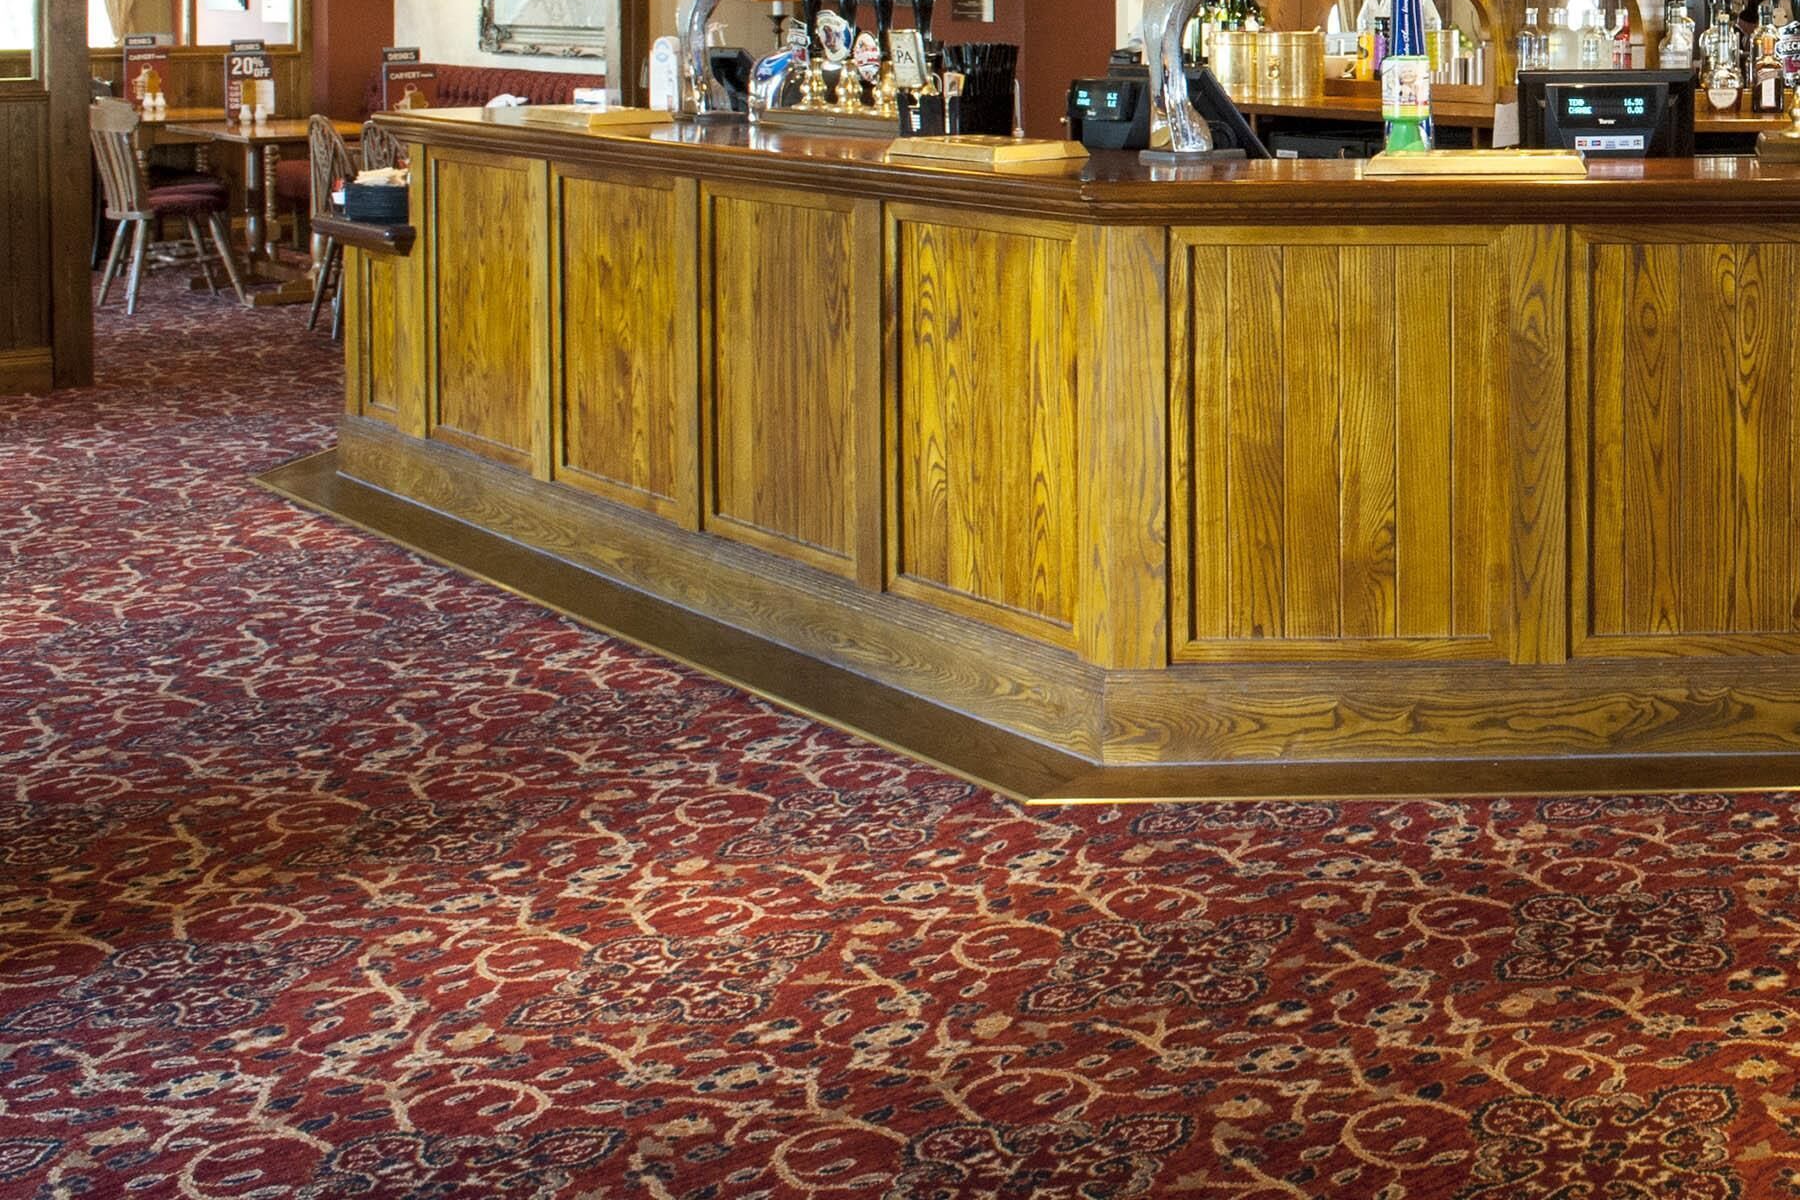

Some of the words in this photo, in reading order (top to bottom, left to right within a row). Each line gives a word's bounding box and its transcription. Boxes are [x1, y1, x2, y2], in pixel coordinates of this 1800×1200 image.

[231, 56, 264, 75] 20%
[253, 67, 271, 77] OFF
[1627, 106, 1644, 115] 0.00
